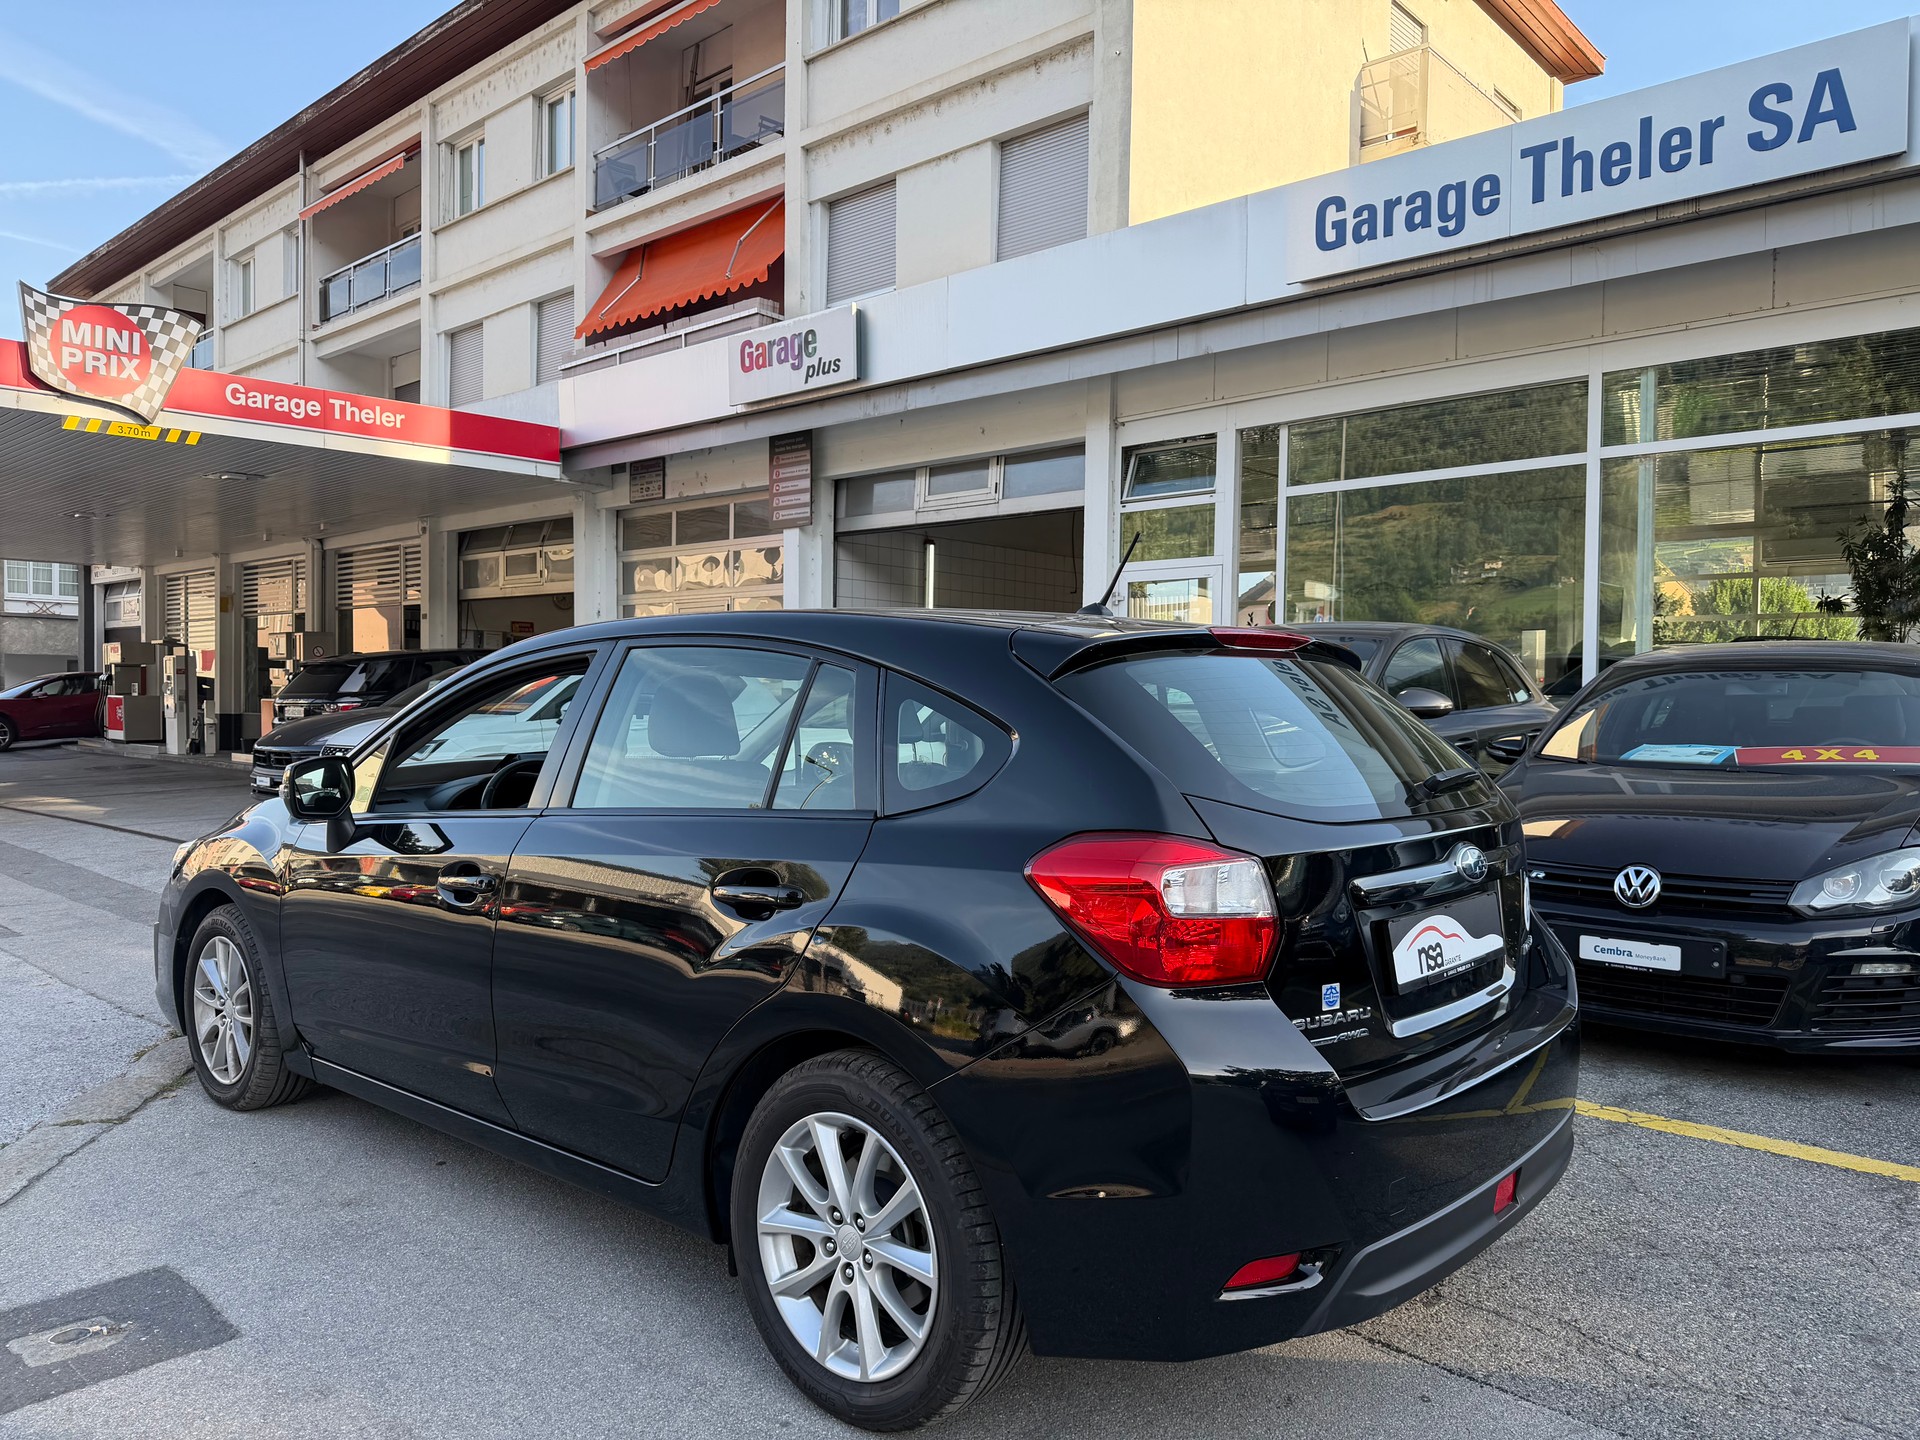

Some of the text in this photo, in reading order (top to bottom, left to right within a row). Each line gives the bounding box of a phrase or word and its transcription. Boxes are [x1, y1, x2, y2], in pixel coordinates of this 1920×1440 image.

[1314, 67, 1857, 251] Garage Theler SA
[61, 319, 141, 356] MINI
[740, 329, 817, 373] Garage
[61, 346, 141, 381] PRIX
[804, 357, 841, 384] plus
[225, 383, 405, 429] Garage Theler
[1417, 942, 1445, 975] nsa
[1593, 944, 1667, 962] Cembra MoneyBank
[1291, 1006, 1372, 1031] SUBARU
